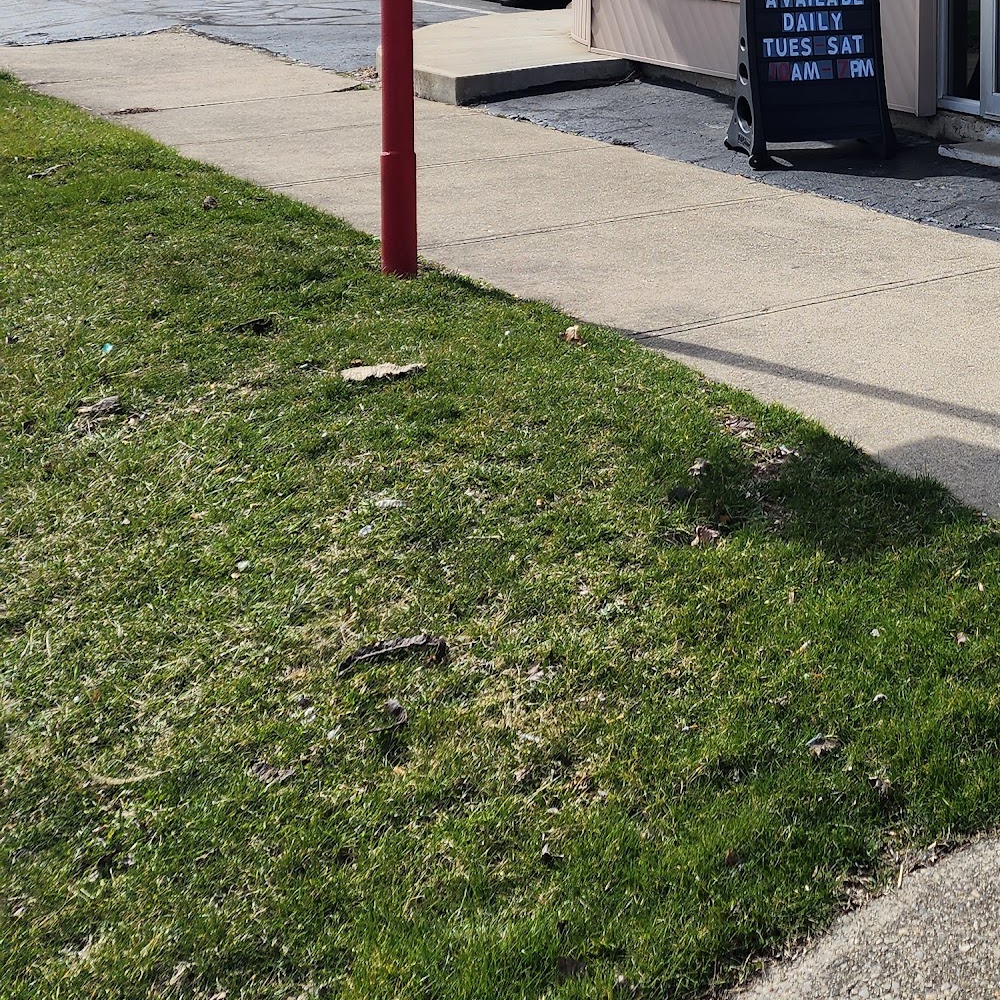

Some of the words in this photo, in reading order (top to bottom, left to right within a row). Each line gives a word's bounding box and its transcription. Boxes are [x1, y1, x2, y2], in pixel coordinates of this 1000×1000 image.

[783, 12, 843, 32] DAILY
[763, 38, 812, 57] TUES
[827, 35, 864, 55] SAT
